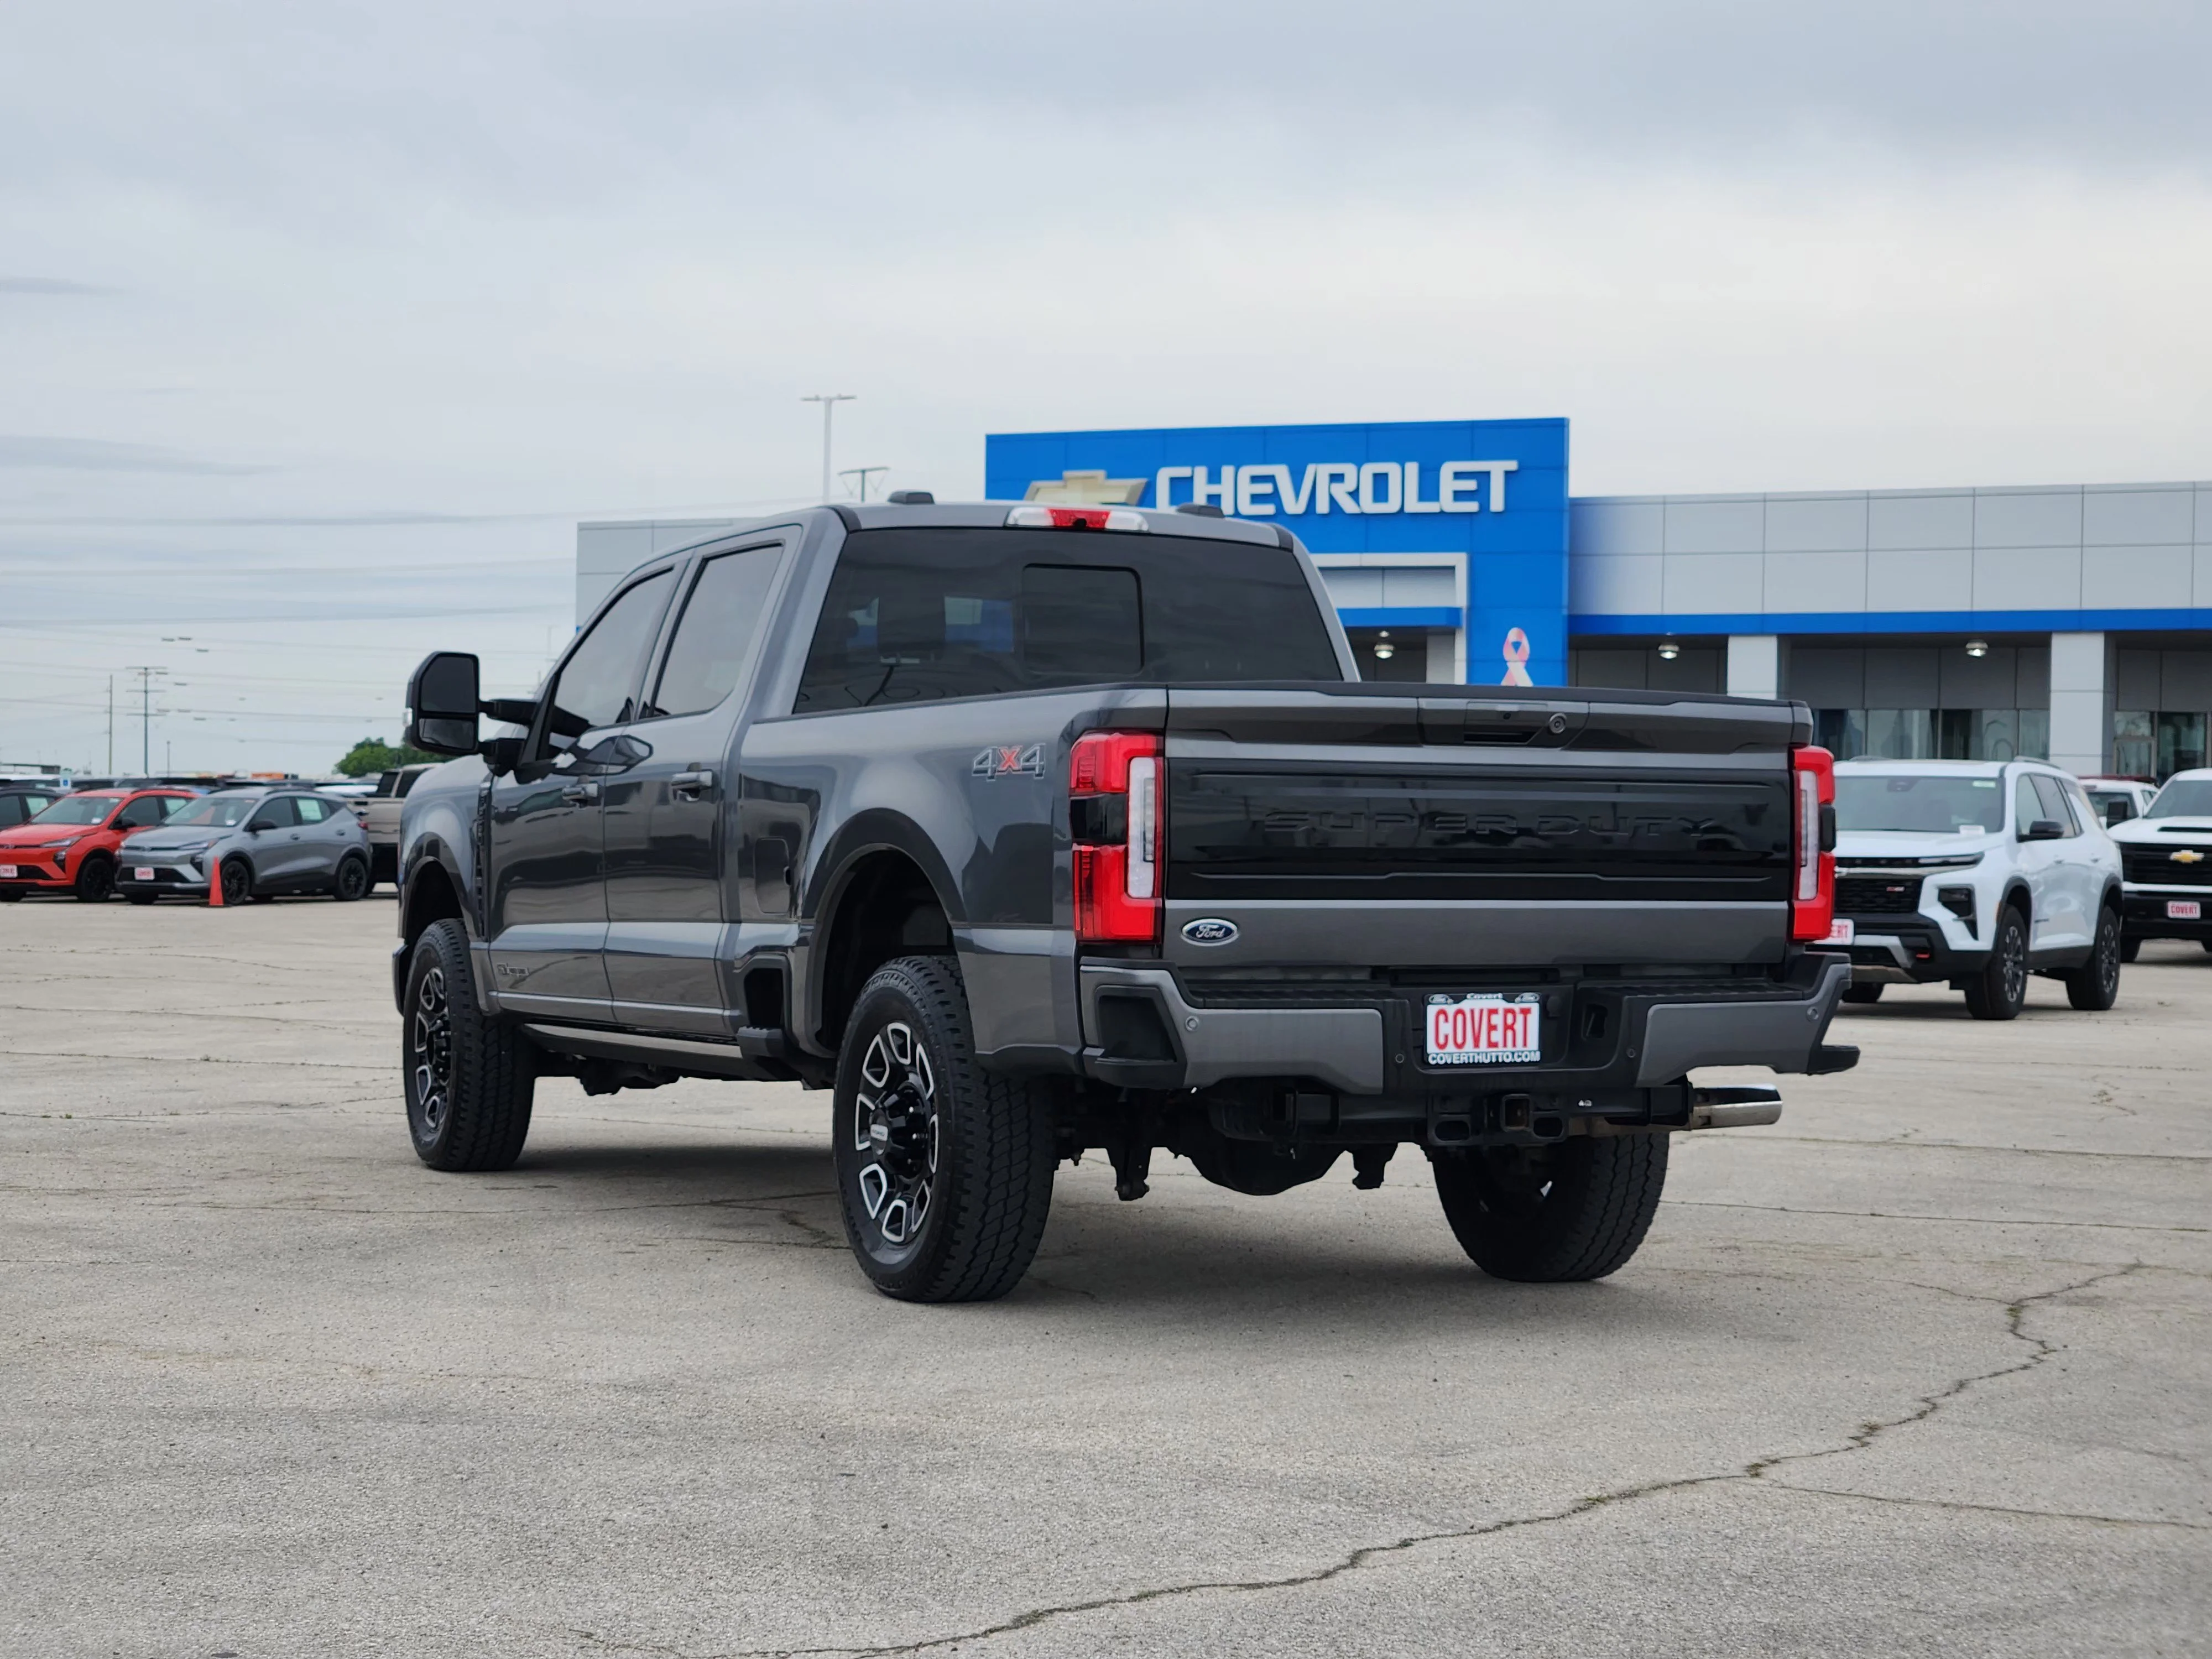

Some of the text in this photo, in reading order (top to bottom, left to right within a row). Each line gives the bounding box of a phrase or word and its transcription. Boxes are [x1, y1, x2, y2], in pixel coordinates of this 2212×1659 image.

[1156, 460, 1519, 516] CHEVROLET
[1265, 811, 1715, 838] SUPER DUTY
[2171, 905, 2197, 914] COVERT
[1196, 924, 1225, 938] Ford
[1434, 1006, 1531, 1050] COVERT
[1428, 1051, 1541, 1065] COVERTHUTTO.COM
